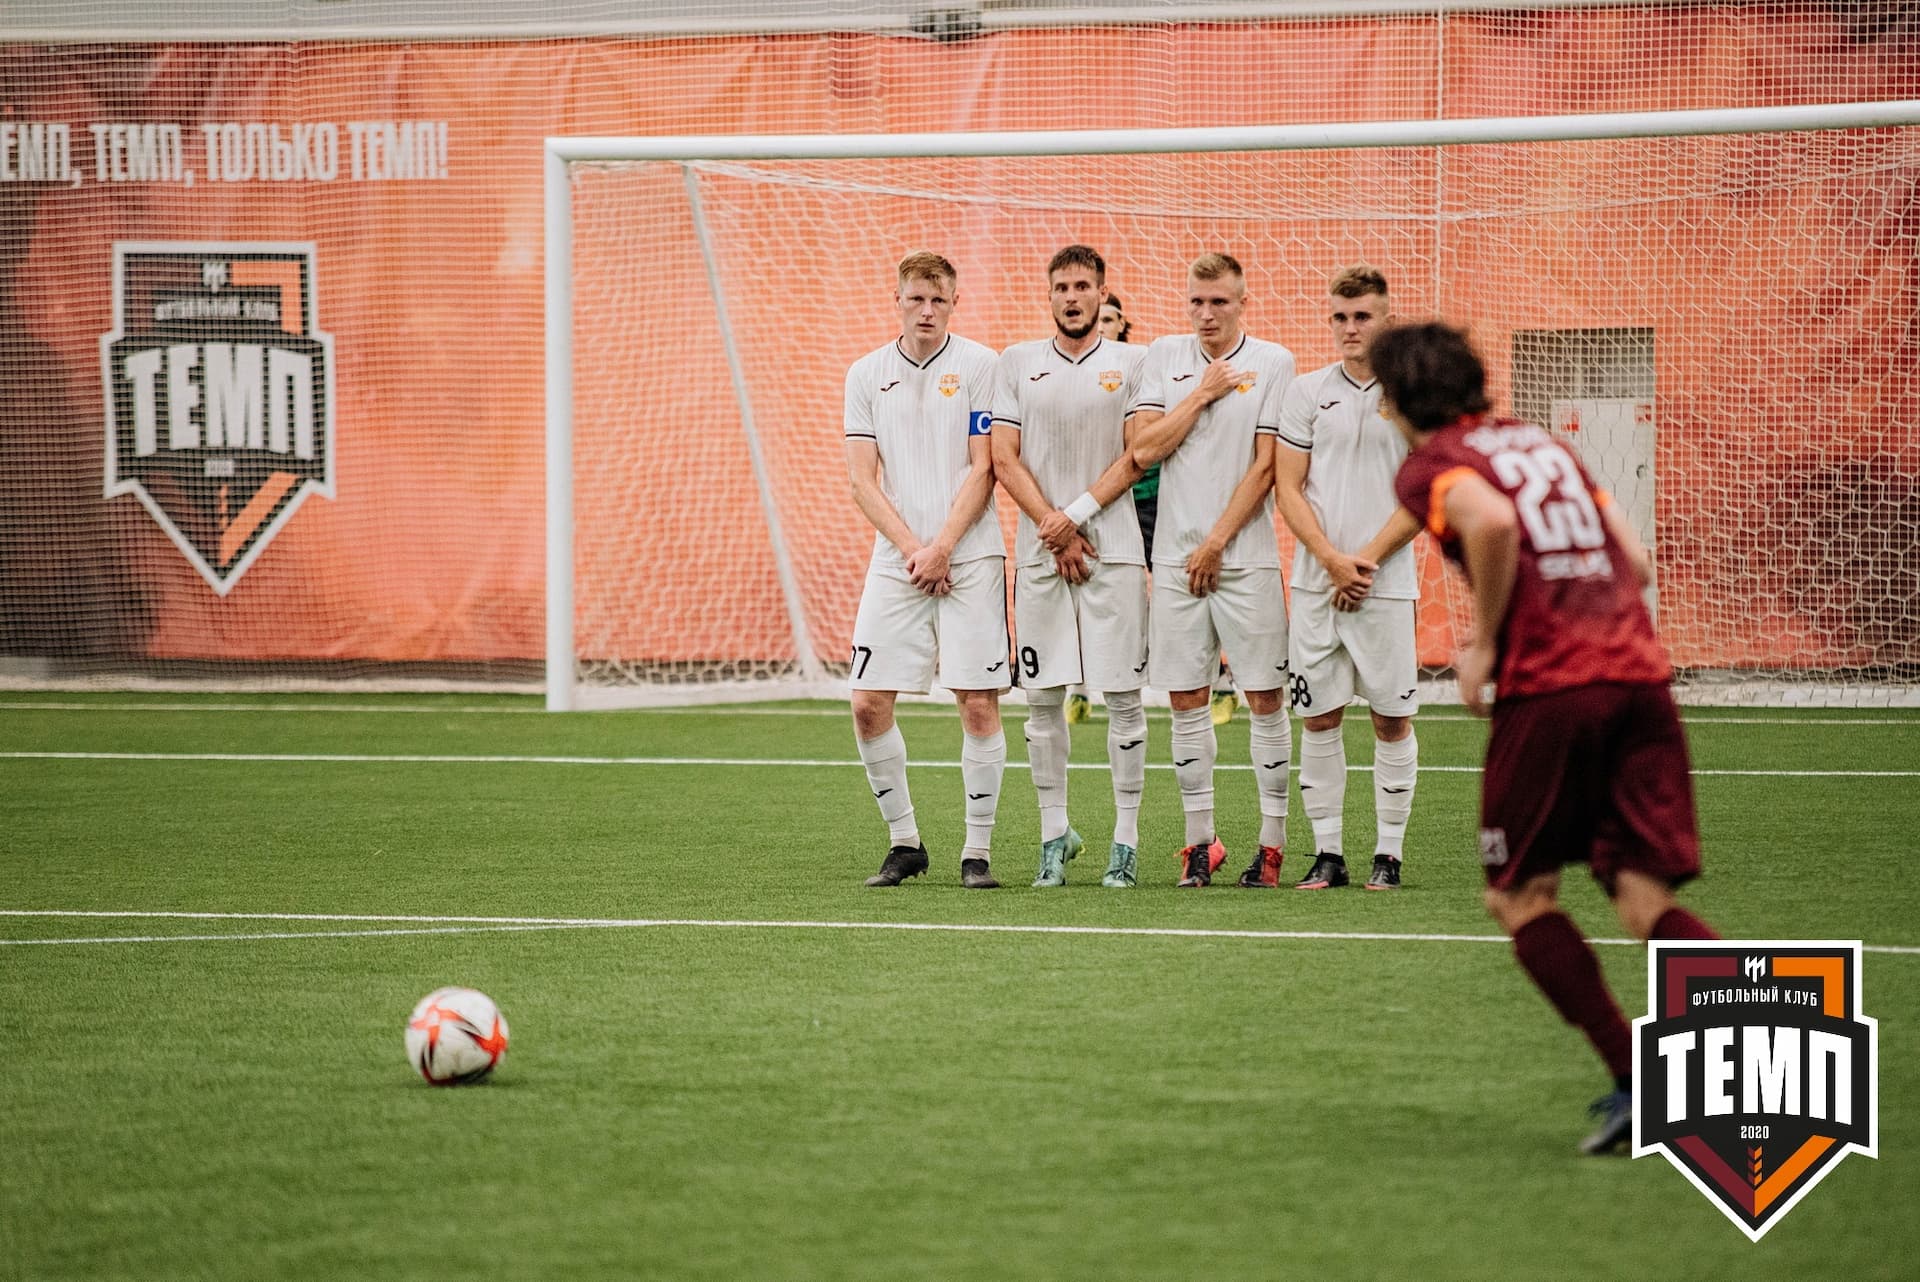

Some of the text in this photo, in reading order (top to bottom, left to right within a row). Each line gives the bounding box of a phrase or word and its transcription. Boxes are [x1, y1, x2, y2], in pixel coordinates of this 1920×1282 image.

[89, 123, 194, 188] ТЕМП,
[202, 122, 337, 181] ТОЛЬКО
[346, 121, 449, 179] ТЕМП!
[125, 342, 314, 461] ТЕМП
[977, 412, 992, 434] C
[1489, 448, 1606, 553] 23
[1021, 646, 1039, 679] 9
